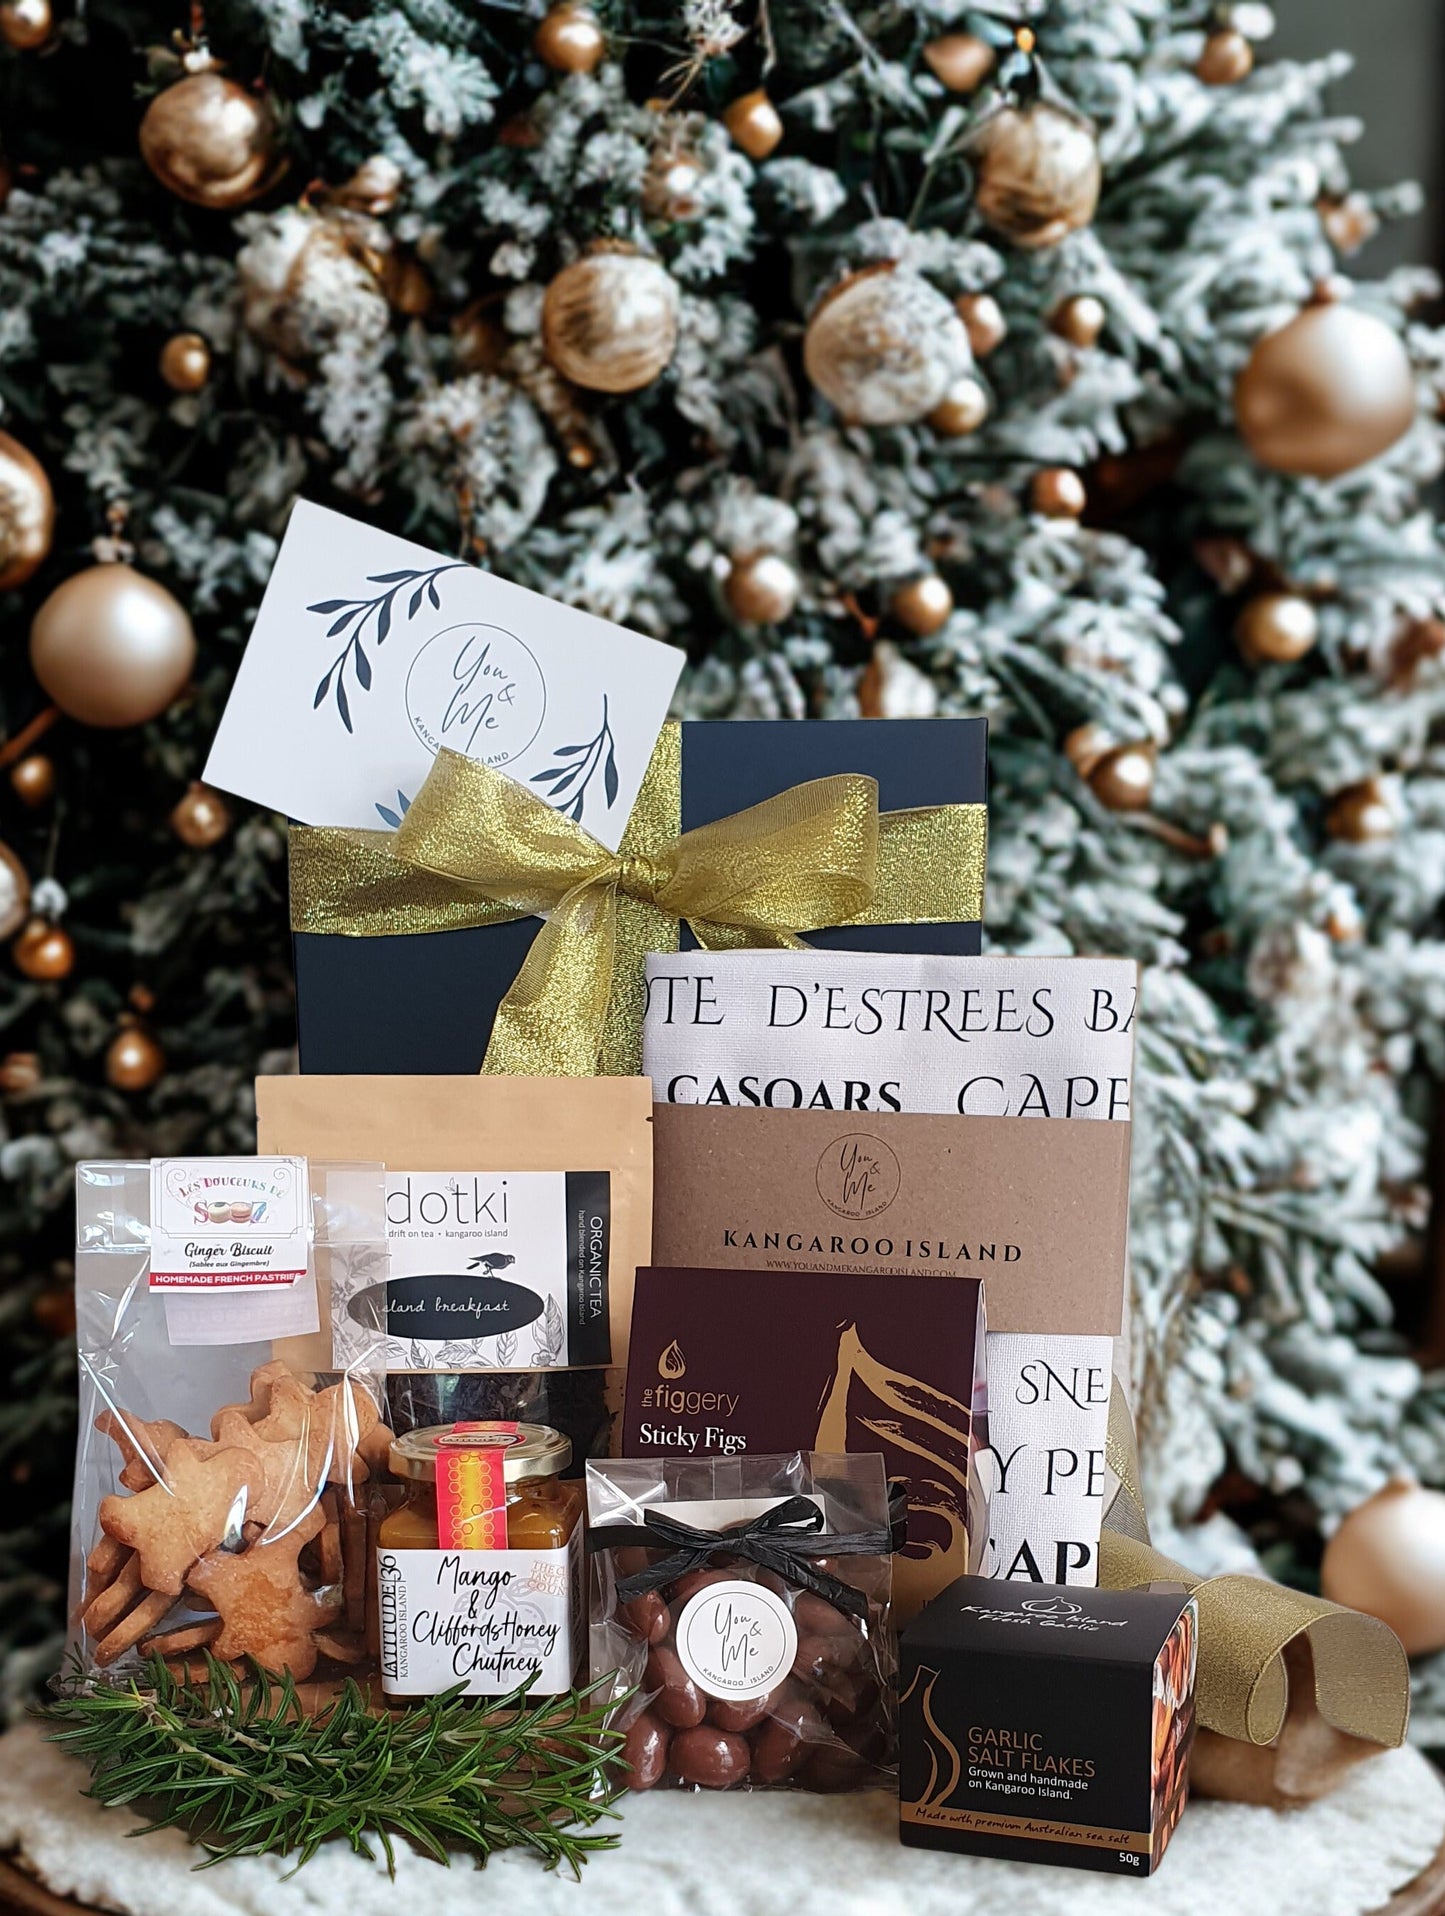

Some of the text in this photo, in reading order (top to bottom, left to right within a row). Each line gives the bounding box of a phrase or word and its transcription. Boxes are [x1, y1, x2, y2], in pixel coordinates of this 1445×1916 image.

[453, 636, 508, 695] You
[497, 683, 516, 705] &
[442, 683, 500, 753] Me
[643, 976, 725, 1025] TE
[767, 982, 1054, 1043] D'ESTREES
[667, 1075, 901, 1113] CASOARS
[840, 1142, 873, 1178] You
[869, 1161, 881, 1175] &
[203, 1176, 267, 1191] DOUCEURS
[843, 1171, 877, 1210] Me
[387, 1176, 507, 1224] dotki
[827, 1199, 887, 1217] KANGAROO ISLAND
[388, 1229, 406, 1238] drift
[421, 1230, 434, 1238] tea
[445, 1229, 483, 1239] kangaroo
[484, 1229, 508, 1237] island
[723, 1229, 1022, 1263] KANGAROO ISLAND
[185, 1242, 274, 1261] Ginger Biscuit
[230, 1260, 270, 1268] Gingembre)
[155, 1275, 213, 1284] HOMEMADE
[214, 1274, 253, 1283] FRENCH
[435, 1296, 510, 1319] breakfast
[1015, 1359, 1108, 1410] SNE
[641, 1384, 740, 1417] the figgery
[639, 1423, 747, 1455] Sticky Figs
[533, 1561, 555, 1574] THE
[989, 1538, 1101, 1588] AP
[437, 1555, 516, 1609] Mango
[468, 1589, 478, 1619] &
[960, 1605, 1128, 1627] Kangaroo Island
[399, 1584, 408, 1678] KANGAROO ISLAND
[714, 1602, 752, 1642] You
[749, 1620, 762, 1636] &
[978, 1614, 1100, 1631] Fresh Garlic
[452, 1642, 543, 1682] Chutney
[721, 1633, 759, 1678] Me
[703, 1665, 774, 1687] KANGAROO ISLAND
[968, 1726, 1043, 1751] GARLIC
[968, 1746, 1096, 1778] SALT FLAKES
[968, 1766, 1089, 1790] Grown and handmade
[968, 1780, 1073, 1800] on Kangaroo Island.
[915, 1807, 1130, 1844] Made with premium Australian sea salt
[1118, 1852, 1140, 1867] 50g
